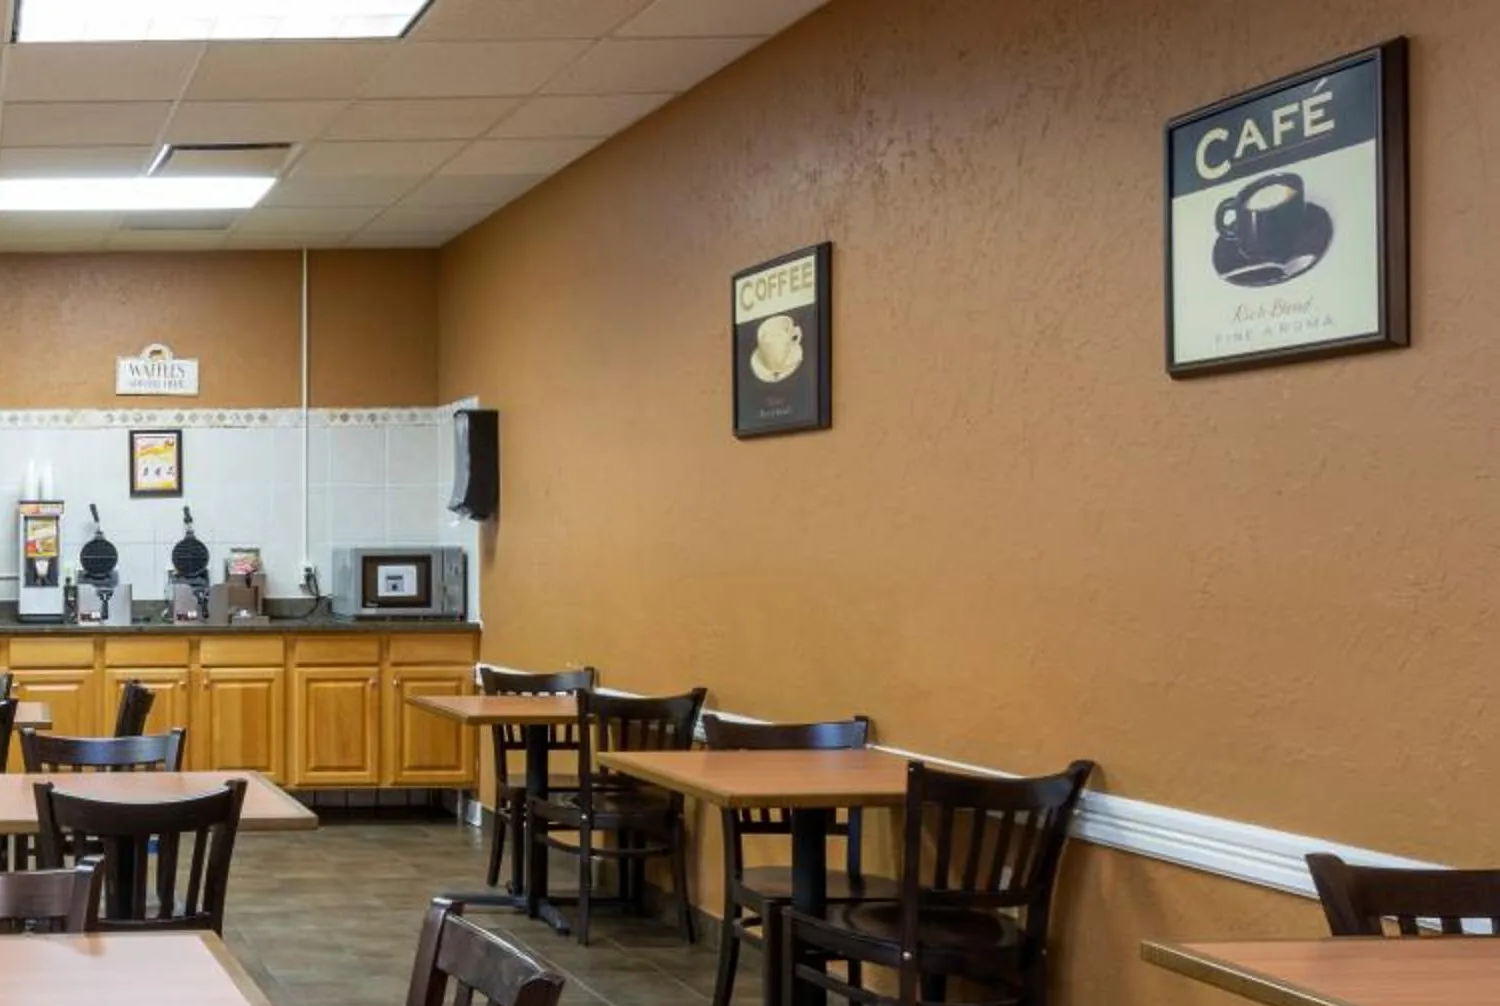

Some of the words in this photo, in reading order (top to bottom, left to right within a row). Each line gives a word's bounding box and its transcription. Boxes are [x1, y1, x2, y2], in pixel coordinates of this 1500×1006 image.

[1195, 78, 1335, 179] CAFÉ
[739, 261, 813, 312] COFFEE
[1214, 328, 1254, 344] FINE
[1262, 314, 1335, 337] AROMA
[127, 362, 186, 379] WAFFLES
